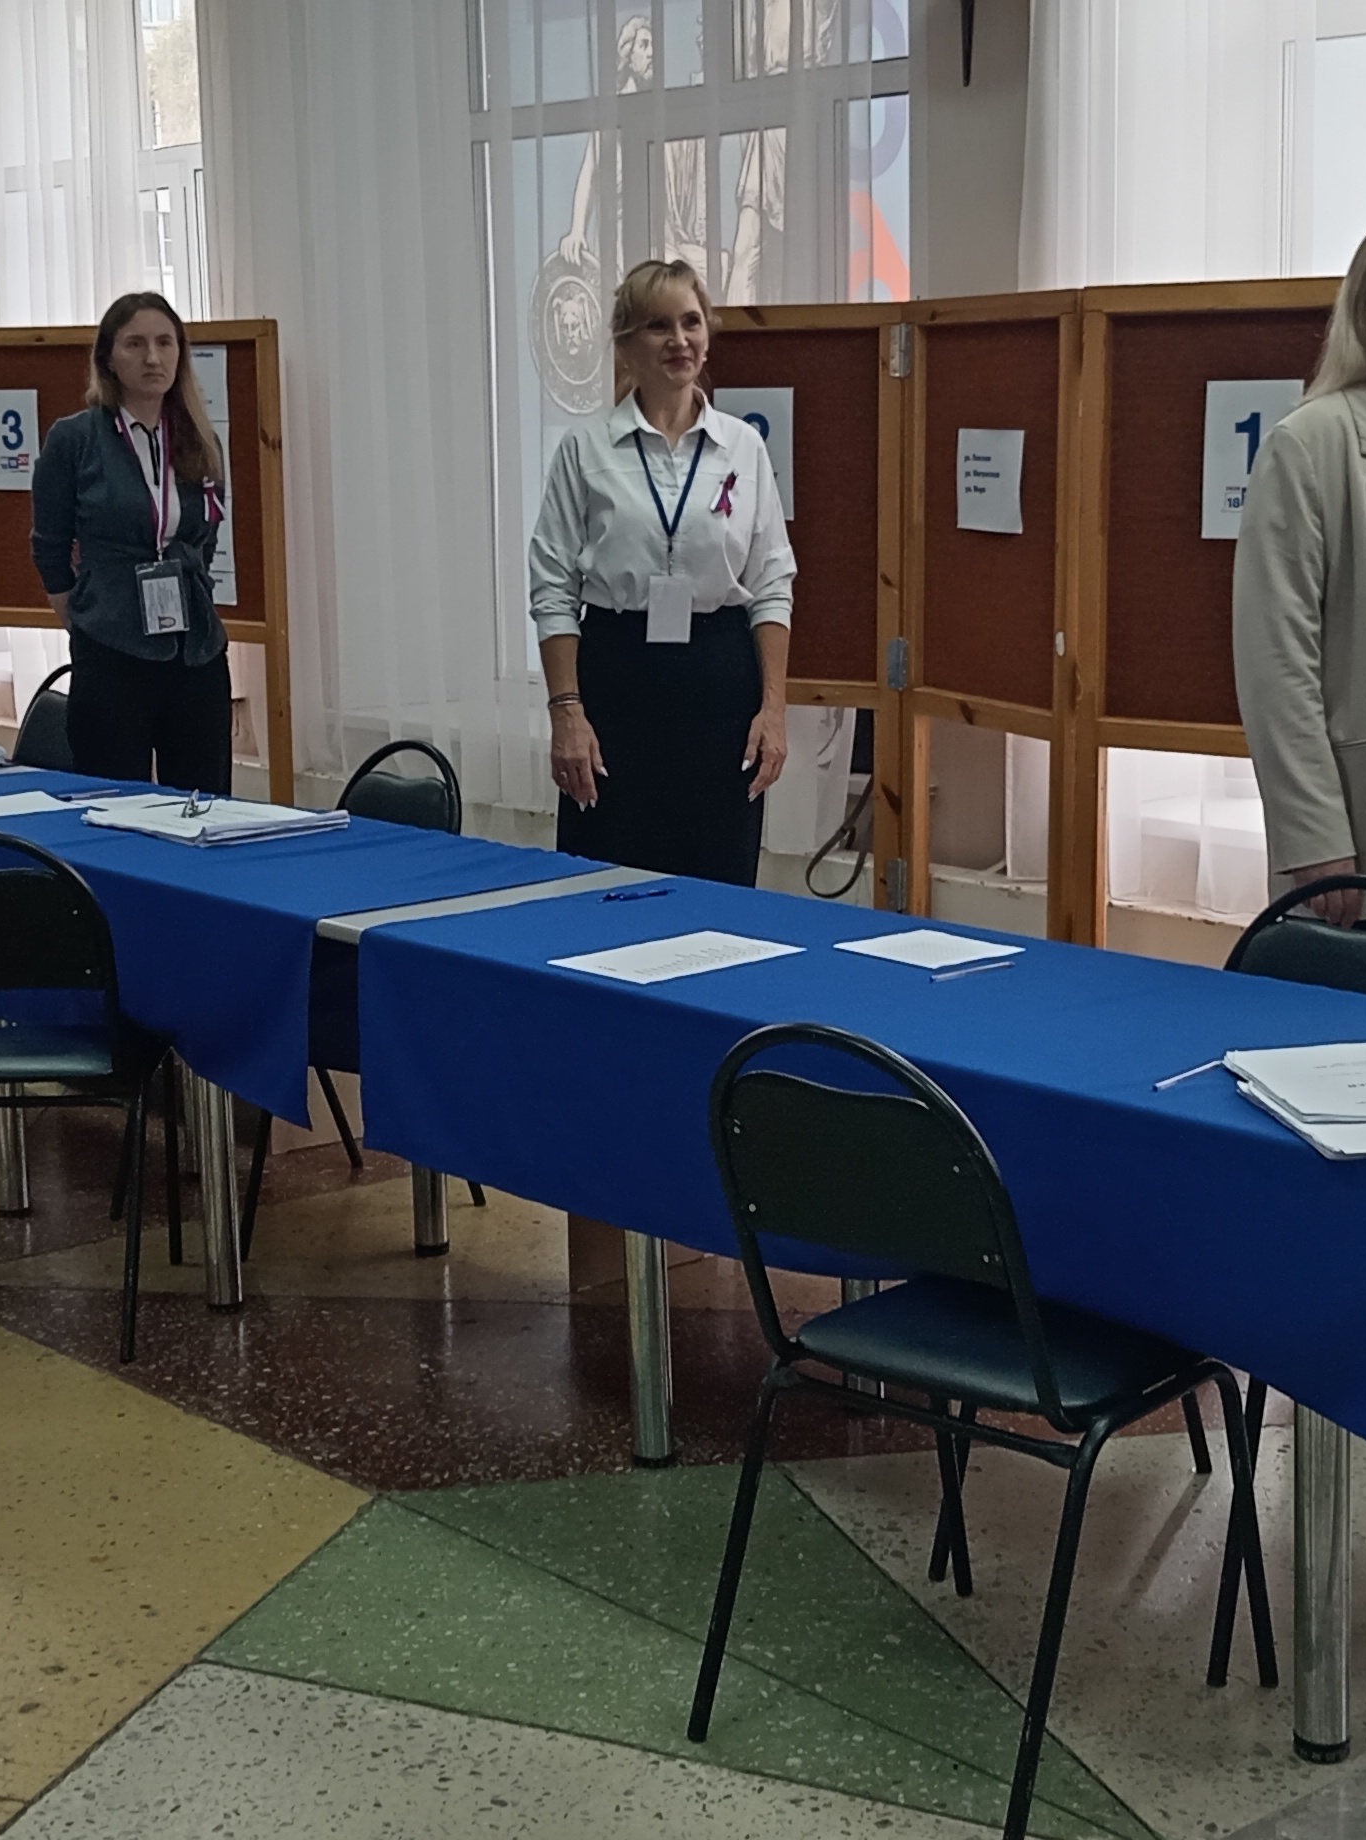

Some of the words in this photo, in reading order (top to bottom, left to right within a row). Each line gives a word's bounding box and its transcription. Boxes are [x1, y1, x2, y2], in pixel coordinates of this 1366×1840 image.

[1, 409, 24, 450] 3
[1235, 412, 1261, 475] 1
[1227, 498, 1241, 508] 18
